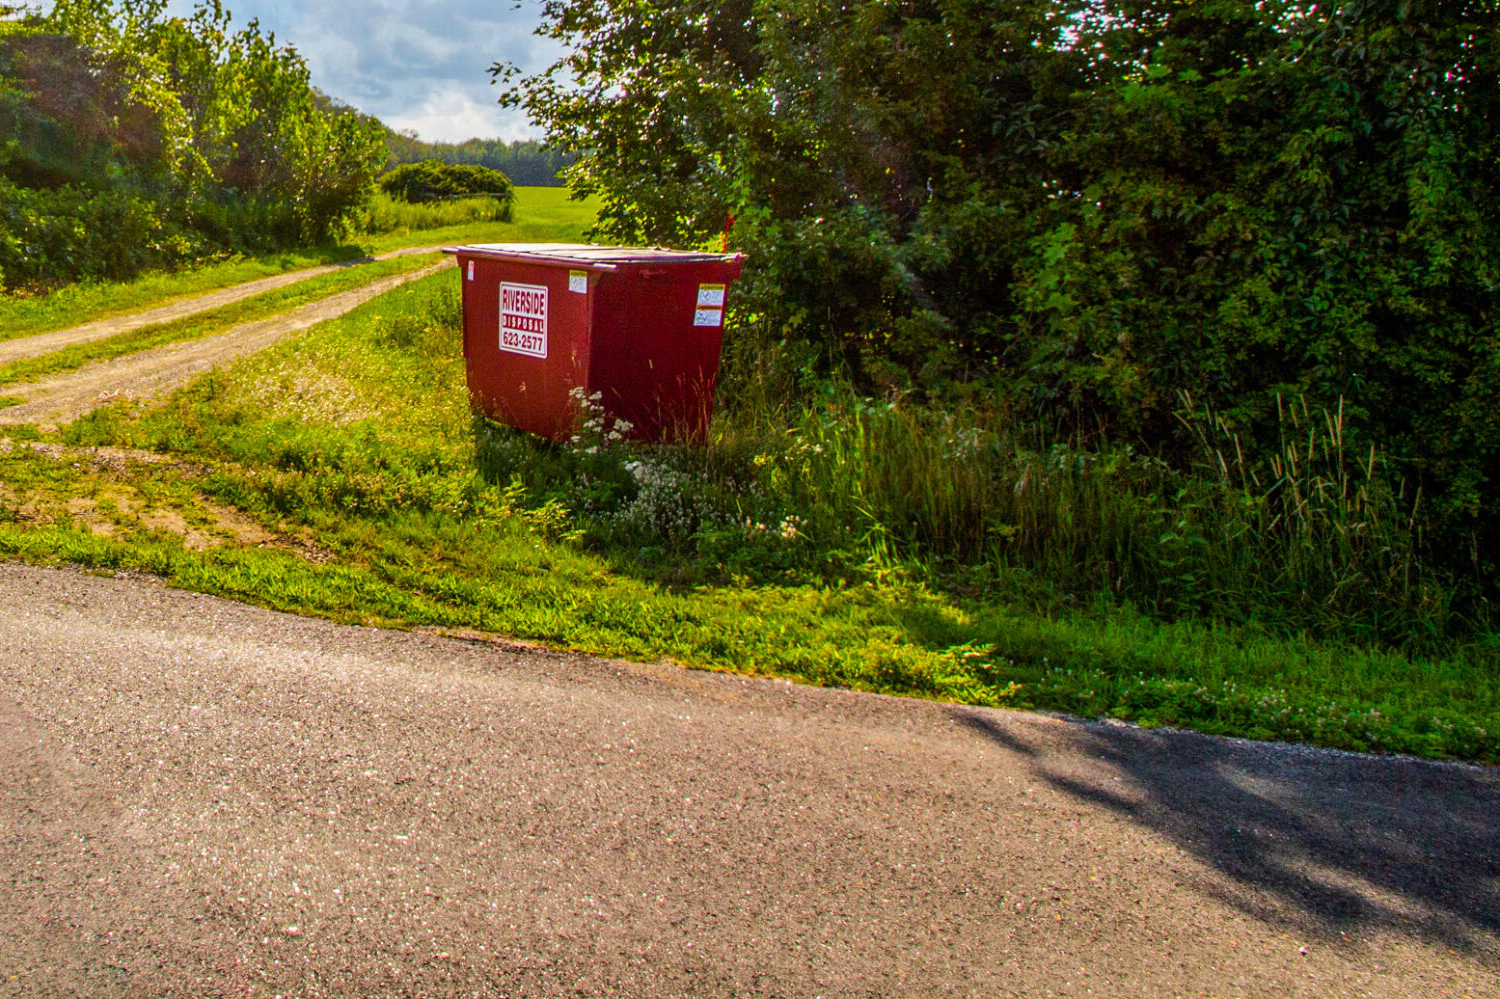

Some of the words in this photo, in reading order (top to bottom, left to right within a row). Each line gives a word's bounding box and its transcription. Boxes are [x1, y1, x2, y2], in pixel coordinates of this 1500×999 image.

[503, 289, 544, 315] RIVERSIDE
[502, 315, 543, 332] DISPOSAL
[503, 331, 543, 351] 623-2577
